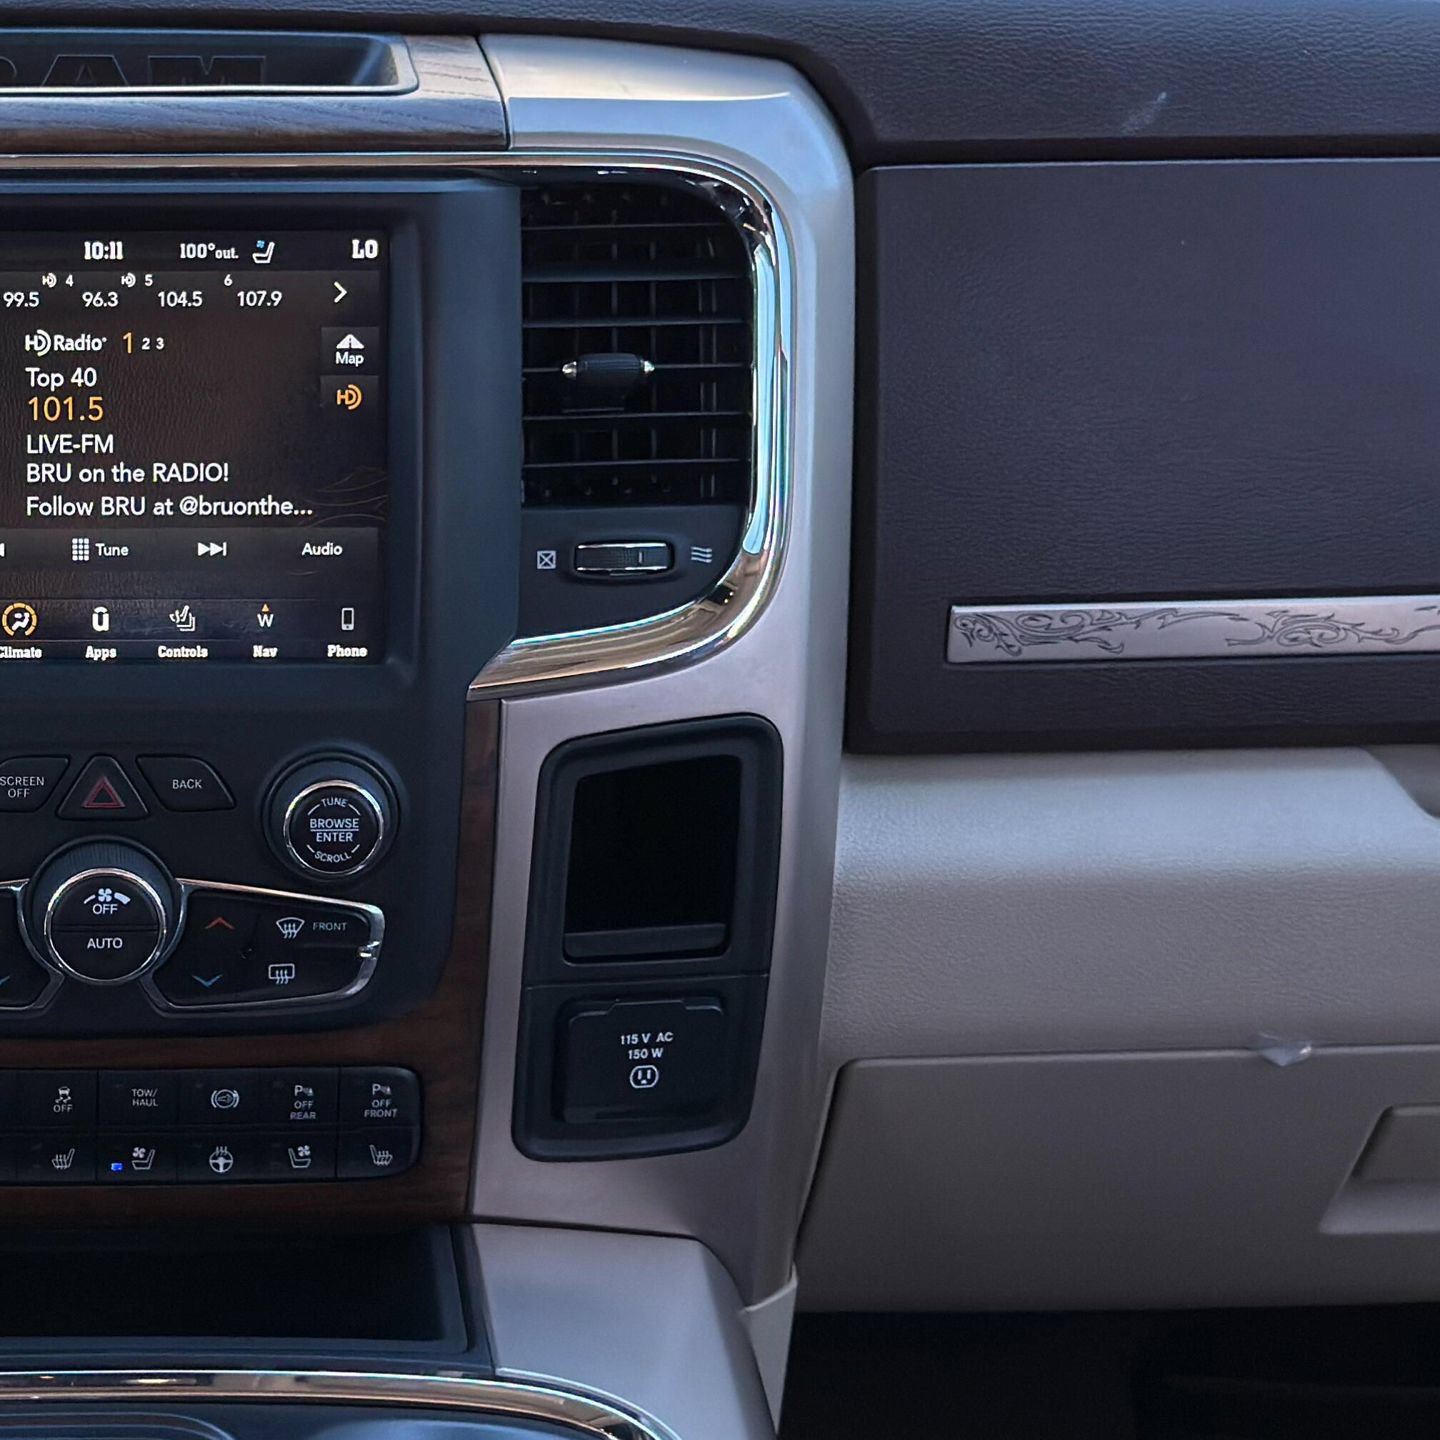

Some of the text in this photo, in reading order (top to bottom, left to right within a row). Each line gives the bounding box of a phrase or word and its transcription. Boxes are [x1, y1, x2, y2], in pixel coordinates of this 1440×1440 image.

[83, 240, 124, 261] 10:11
[351, 239, 379, 260] LO
[65, 274, 75, 288] 4
[144, 274, 154, 287] 5
[223, 274, 234, 287] 6
[3, 291, 40, 309] 99.5
[81, 291, 119, 309] 96.3
[157, 290, 204, 308] 104.5
[236, 290, 283, 308] 107.9
[122, 331, 133, 355] 1
[141, 337, 151, 351] 2
[156, 337, 166, 351] 3
[335, 351, 365, 368] Map
[25, 367, 98, 392] Top 40
[28, 395, 105, 422] 101.5
[26, 433, 115, 455] LIVE-FM
[26, 462, 229, 484] BRU on the RADIO!
[26, 496, 94, 517] Follow
[100, 496, 147, 517] BRU
[153, 498, 175, 517] at
[95, 542, 129, 558] Tune
[301, 541, 344, 557] Audio
[85, 645, 117, 662] Apps
[157, 645, 209, 659] Controls
[252, 644, 279, 659] Nav
[326, 643, 369, 658] Phone
[0, 775, 46, 787] SCREEN
[172, 777, 204, 791] BACK
[7, 788, 31, 799] OFF
[320, 796, 348, 808] TUNE
[309, 817, 360, 829] BROWSE
[315, 831, 354, 842] ENTER
[314, 850, 352, 863] SCROLL
[92, 903, 118, 916] OFF
[312, 921, 348, 933] FRONT
[86, 937, 123, 951] AUTO
[620, 1030, 674, 1046] 115 V AC
[627, 1046, 664, 1060] 150 W
[131, 1088, 158, 1098] TOW/
[53, 1104, 73, 1113] OFF
[132, 1098, 159, 1108] HAUL
[293, 1100, 314, 1110] OFF
[371, 1099, 391, 1109] OFF
[289, 1111, 317, 1120] REAR
[364, 1108, 398, 1119] FRONT
